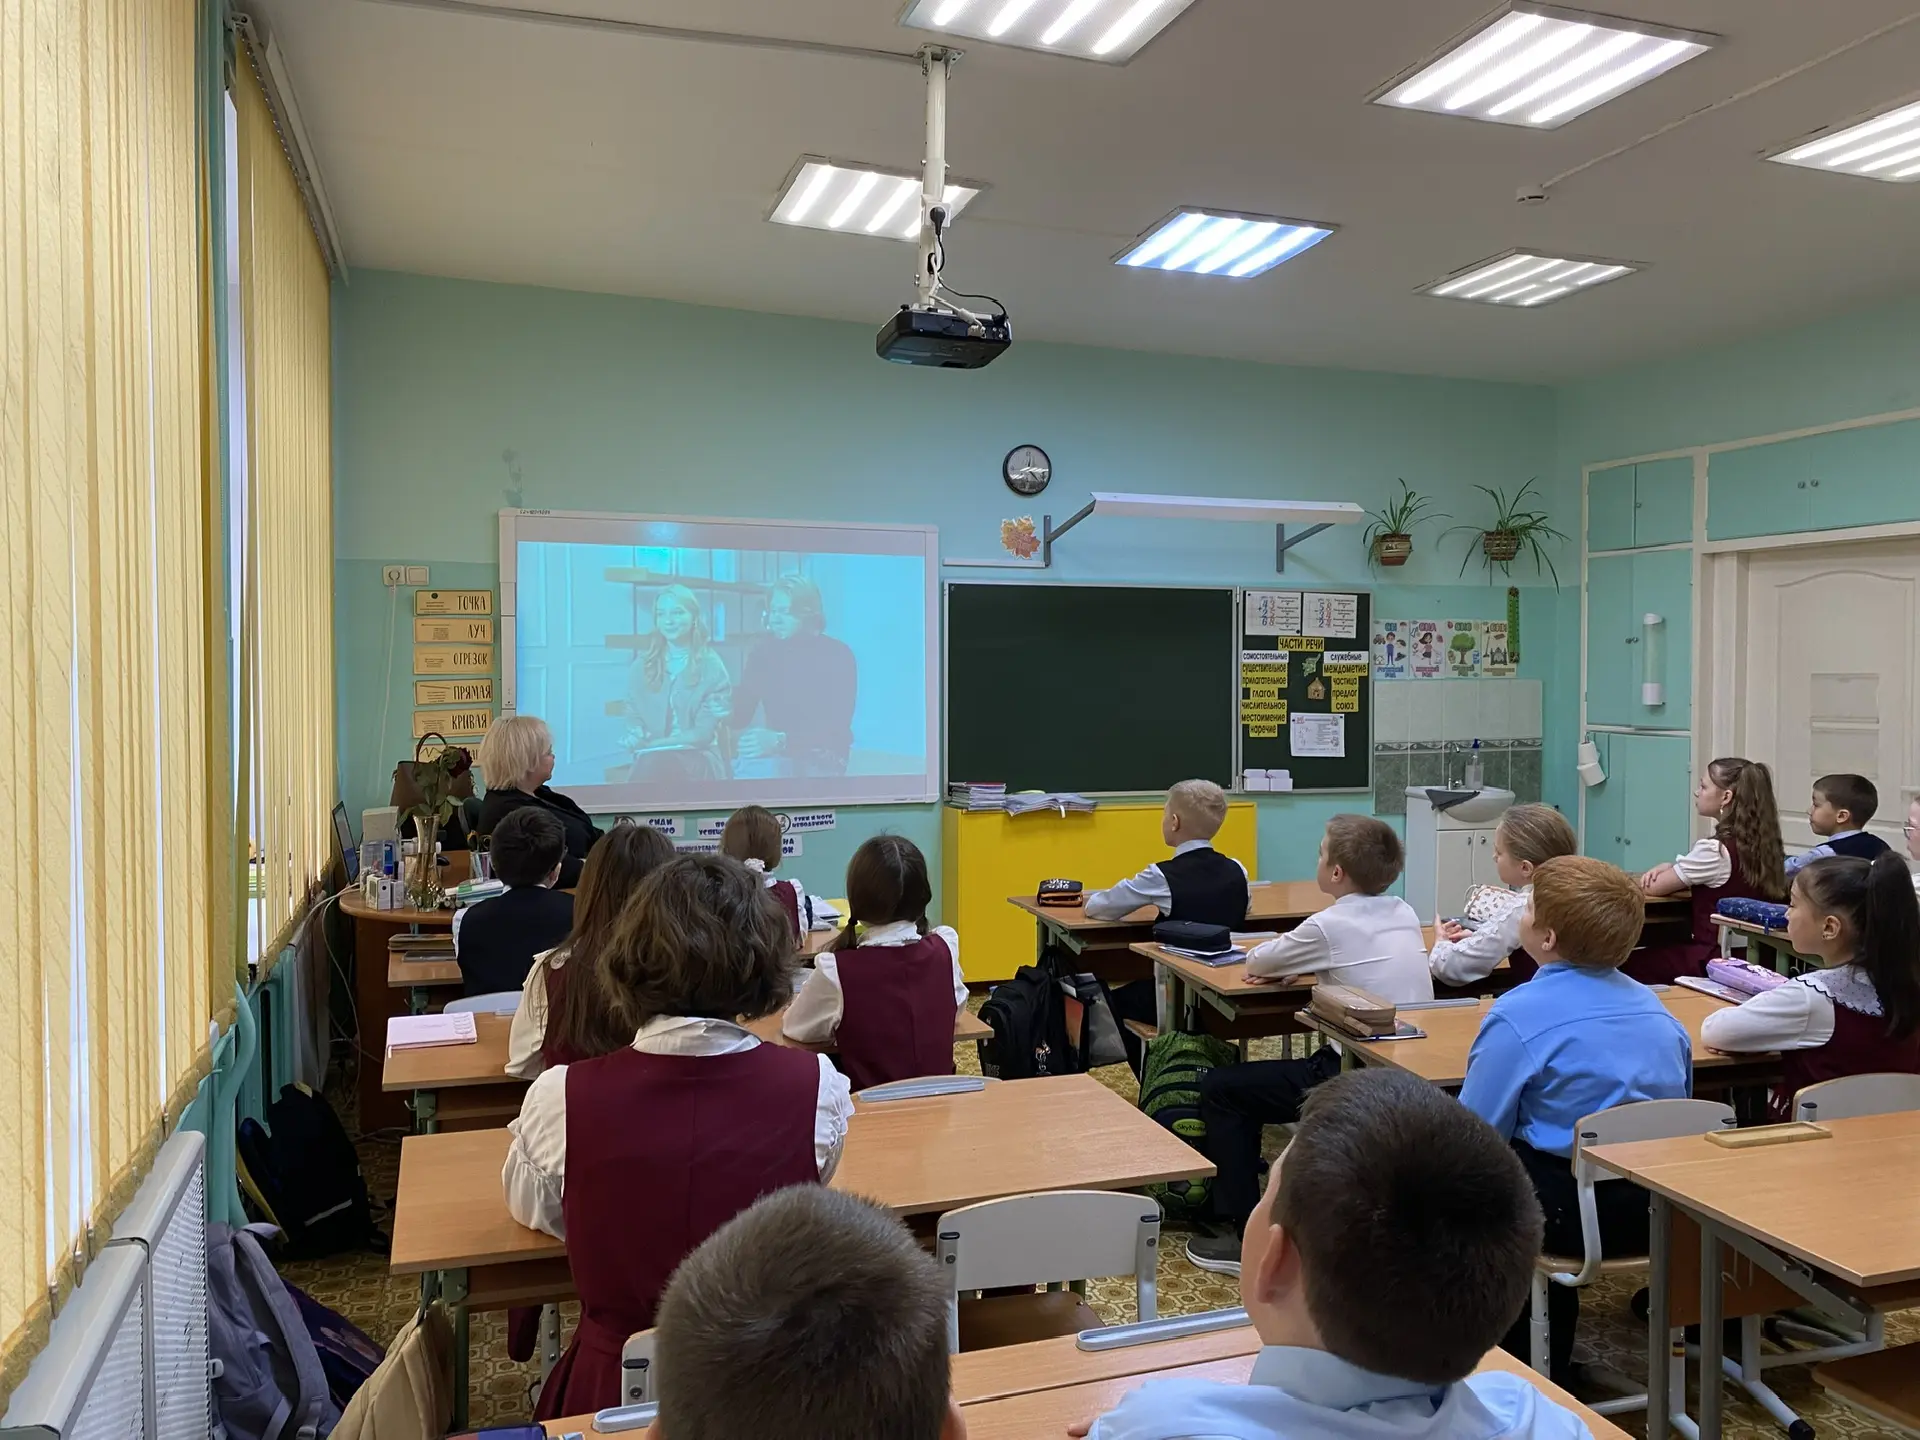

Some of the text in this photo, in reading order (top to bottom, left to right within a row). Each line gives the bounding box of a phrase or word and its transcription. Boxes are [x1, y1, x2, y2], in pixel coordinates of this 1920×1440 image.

[457, 595, 486, 611] ТОЧКА
[467, 624, 486, 639] ЛУЧ
[1279, 639, 1324, 650] ЧАСТИ РЕЧИ
[453, 652, 488, 665] ОТРЕЗОК
[1242, 652, 1288, 661] самостоятельные
[1330, 652, 1362, 663] служебные
[1242, 664, 1287, 675] существительное
[1323, 664, 1367, 674] междометие
[1242, 677, 1287, 687] прилагательное
[1332, 678, 1357, 687] частица
[453, 684, 491, 700] ПРЯМАЯ
[1252, 689, 1276, 698] глагол
[1332, 689, 1358, 700] предлог
[1241, 702, 1286, 710] числительное
[1335, 702, 1354, 710] союз
[451, 713, 487, 730] КРИВАЯ
[1241, 714, 1286, 722] местоимение
[1250, 725, 1276, 737] наречие
[648, 818, 673, 826] СИДИ
[698, 828, 725, 836] УСПЕШ
[782, 846, 794, 854] ОК
